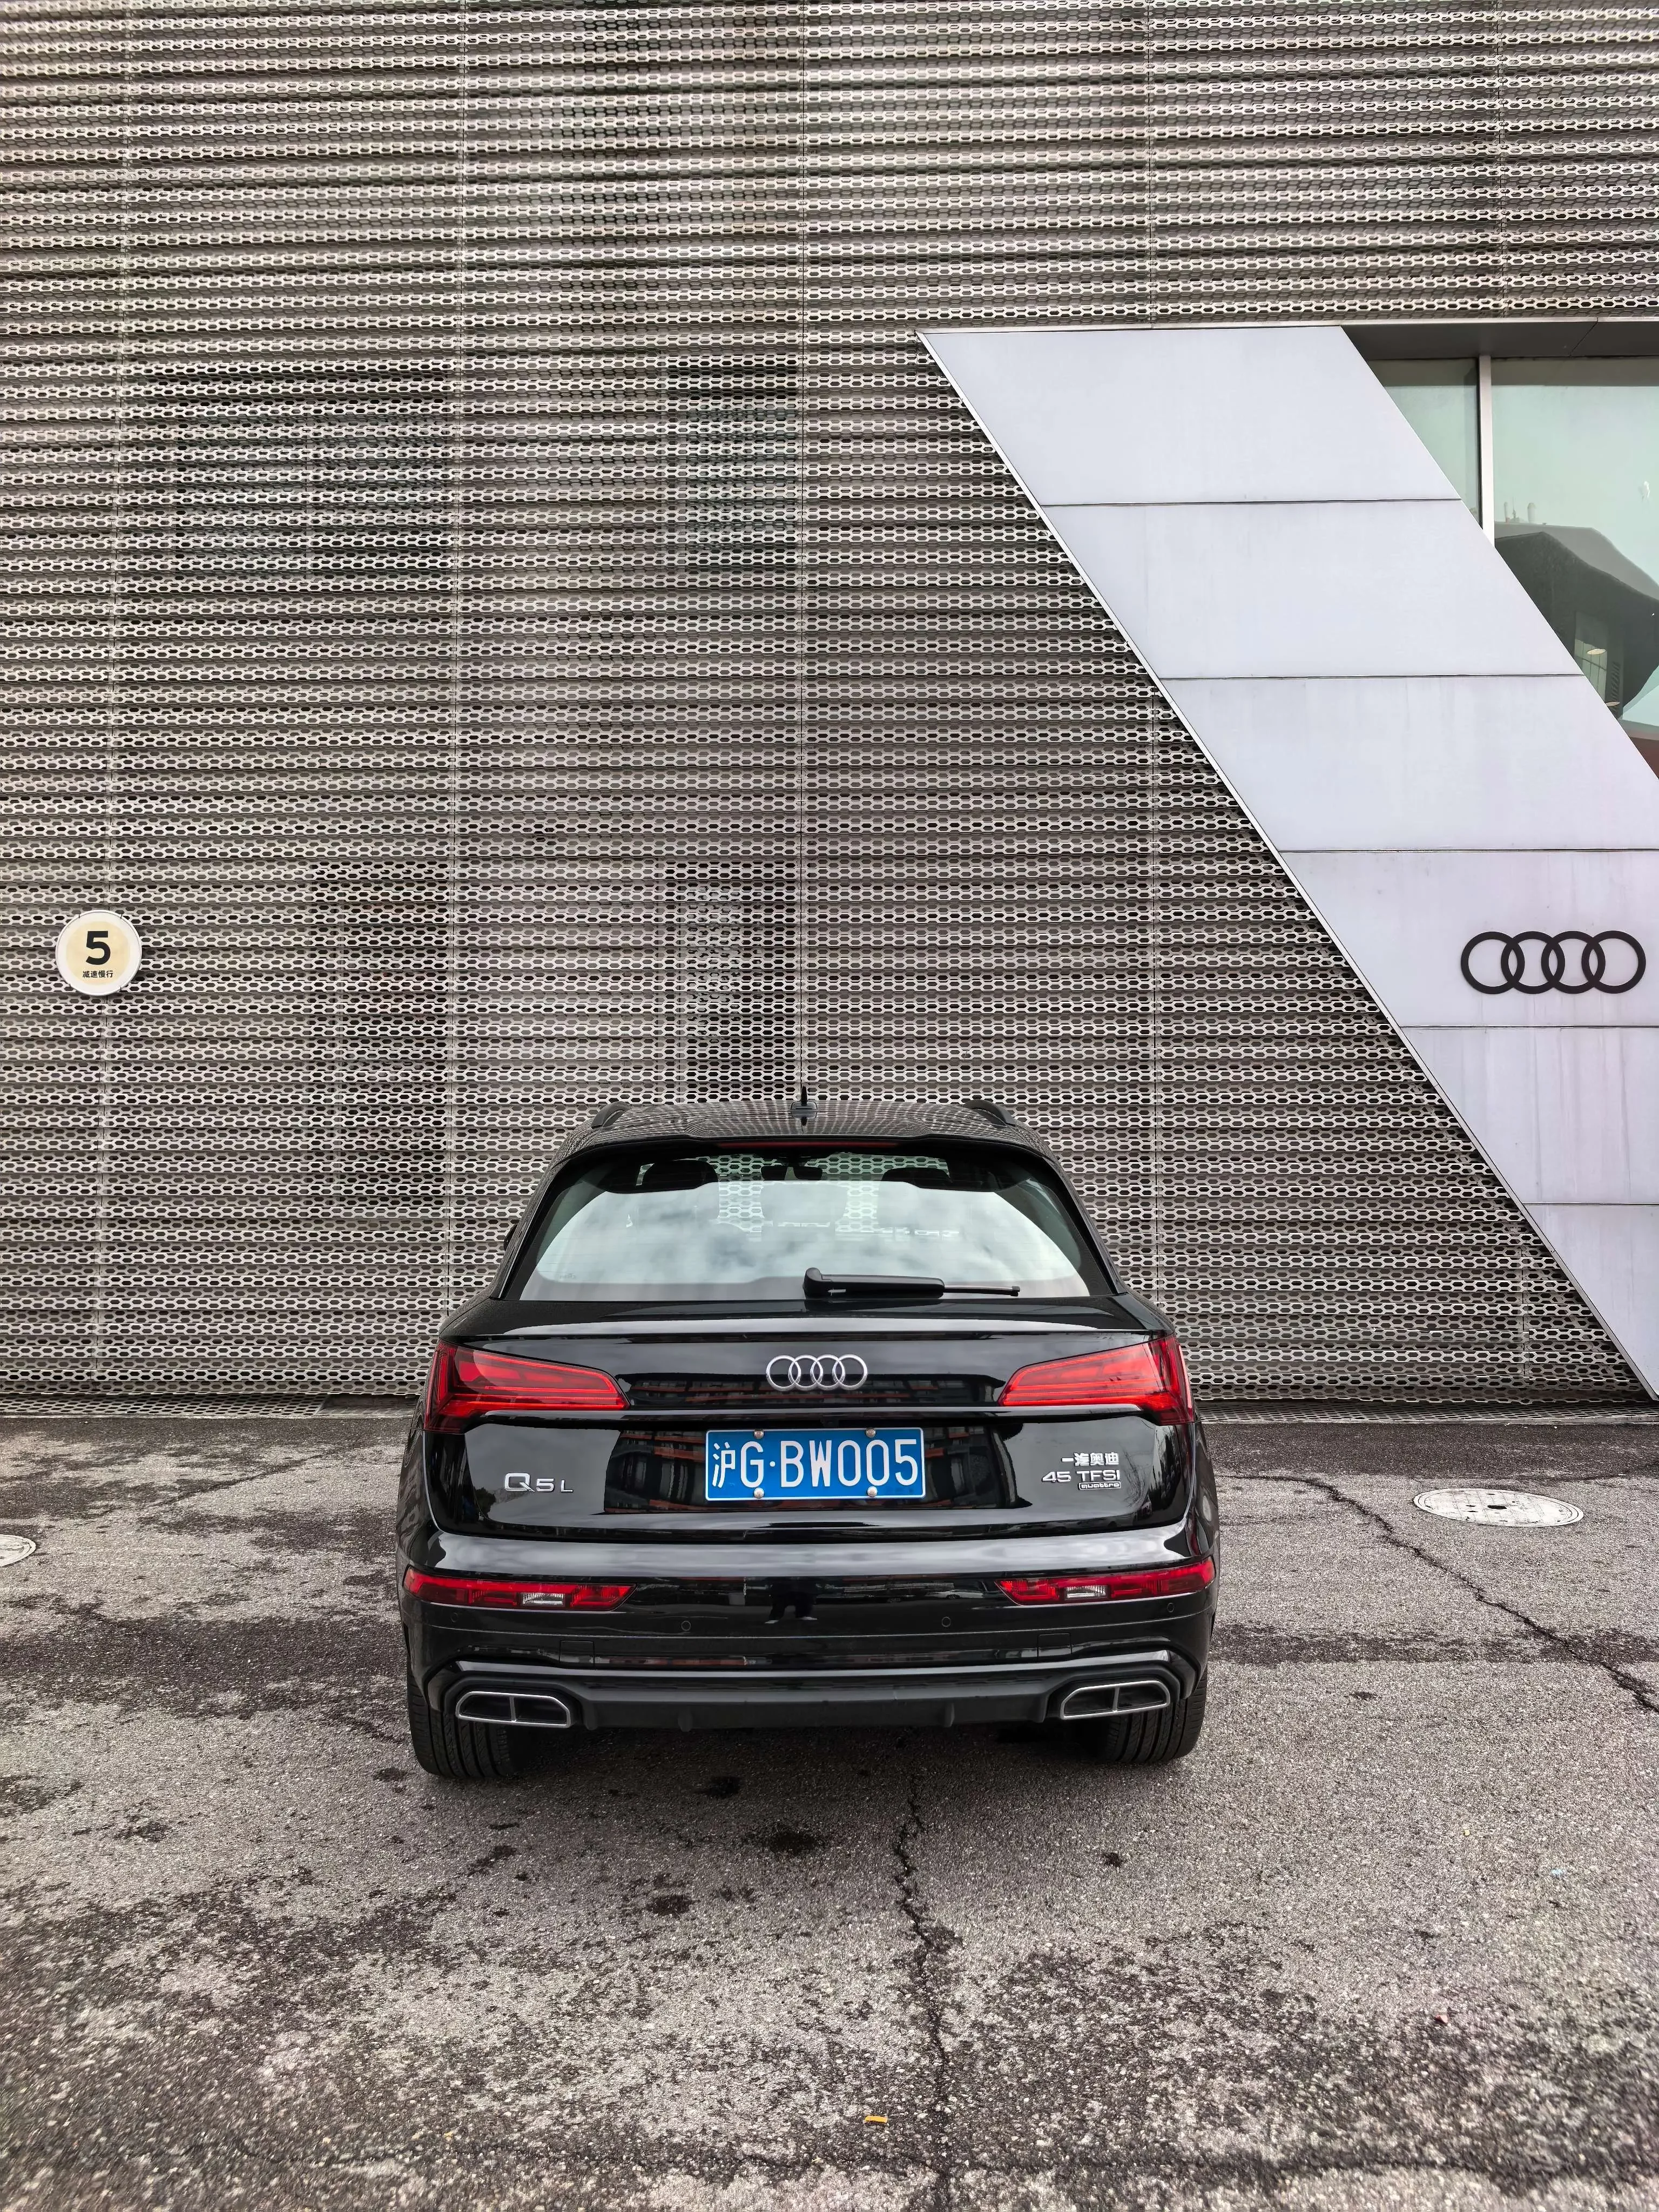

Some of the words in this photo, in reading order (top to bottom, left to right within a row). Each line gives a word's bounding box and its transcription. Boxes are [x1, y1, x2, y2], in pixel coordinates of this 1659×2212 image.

[86, 930, 111, 966] 5
[82, 970, 113, 978] 减速慢行
[1061, 1452, 1120, 1466] 一汽奥迪
[1042, 1471, 1071, 1483] 45
[1076, 1469, 1121, 1482] TFSI
